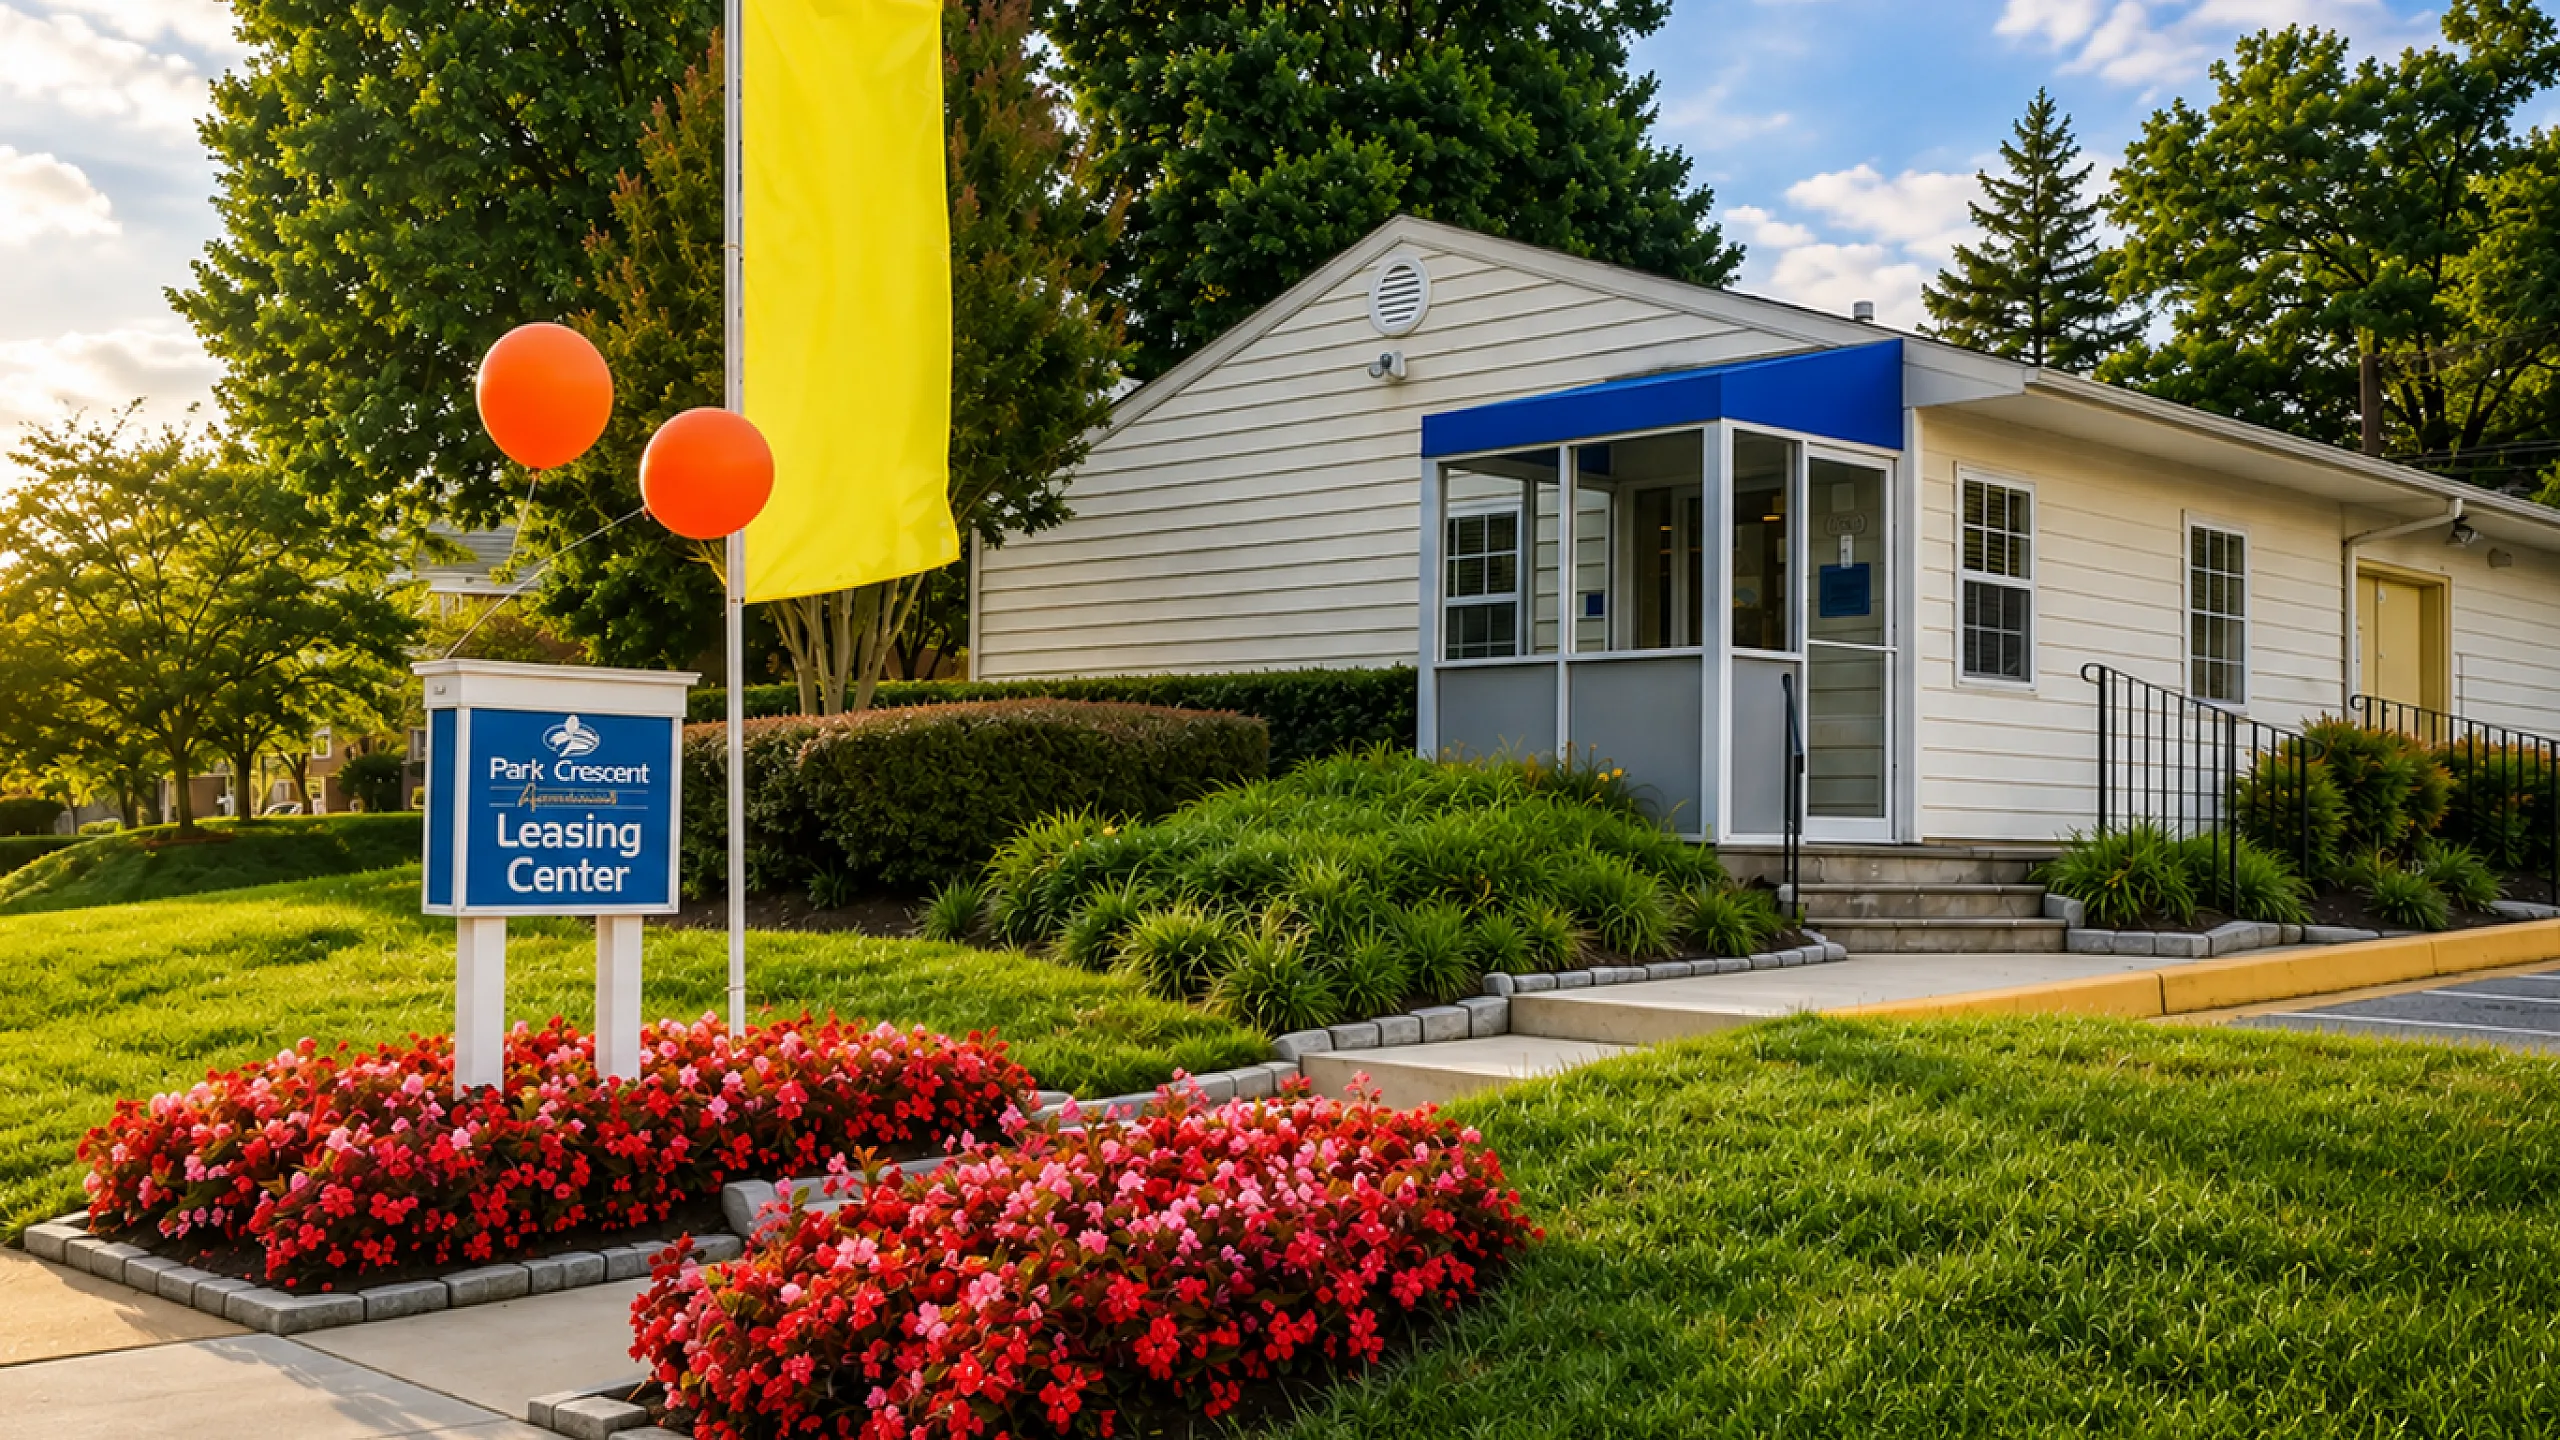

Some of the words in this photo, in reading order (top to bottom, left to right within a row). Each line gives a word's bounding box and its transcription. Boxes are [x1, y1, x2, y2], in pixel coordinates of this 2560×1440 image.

[490, 758, 545, 780] Park
[554, 760, 650, 784] Crescent
[497, 813, 641, 857] Leasing
[507, 857, 630, 892] Center
